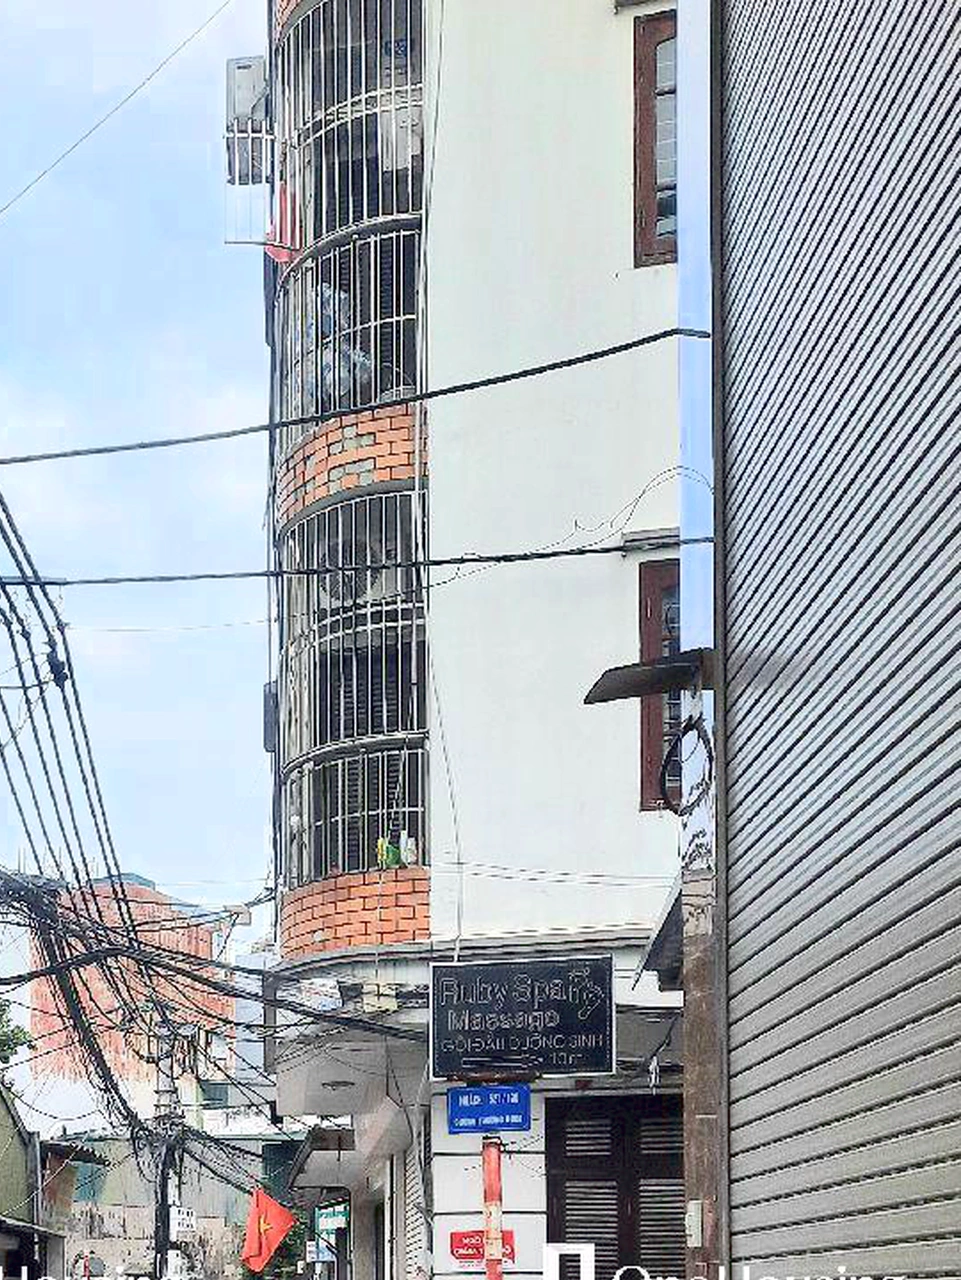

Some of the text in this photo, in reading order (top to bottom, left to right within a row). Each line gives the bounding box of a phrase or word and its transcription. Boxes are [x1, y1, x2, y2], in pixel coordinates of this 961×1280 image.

[440, 974, 567, 1010] Ruby Spa
[448, 1010, 559, 1033] Massage
